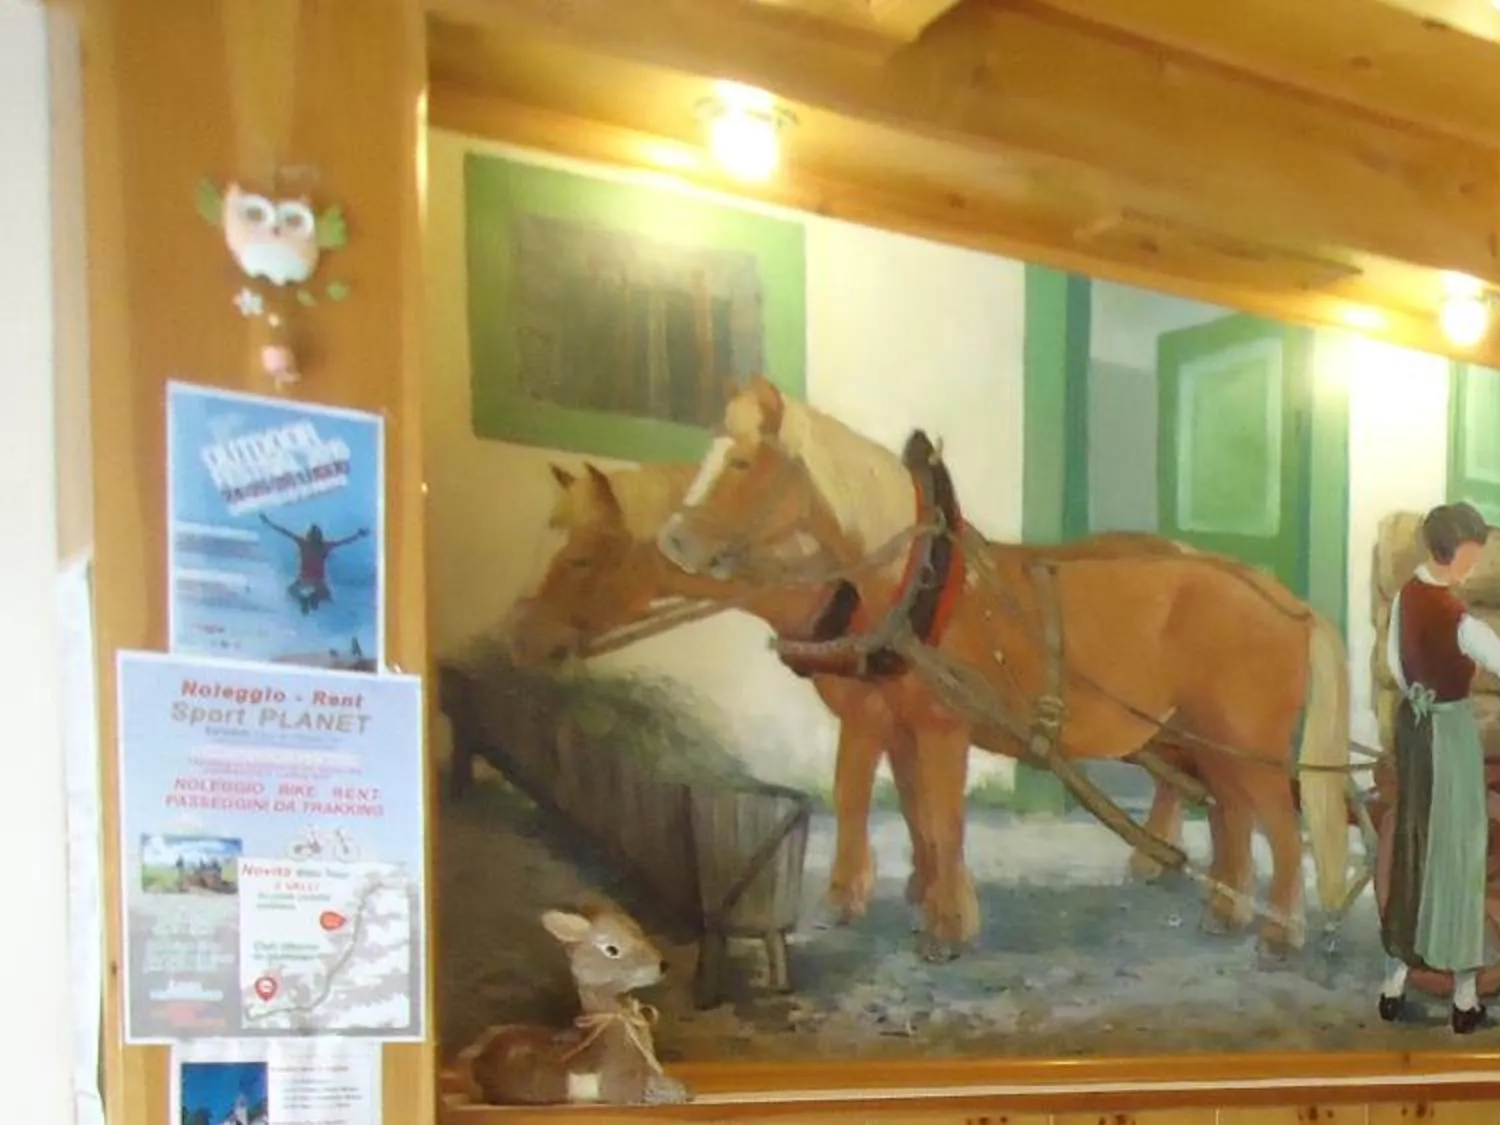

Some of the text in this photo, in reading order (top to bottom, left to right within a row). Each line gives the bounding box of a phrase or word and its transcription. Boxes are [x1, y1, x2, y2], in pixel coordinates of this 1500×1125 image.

[181, 679, 286, 704] Noleggio
[312, 689, 364, 708] Rent
[171, 701, 371, 734] Sport PLANET
[174, 777, 379, 801] NOLEGGIO BIKE RENT
